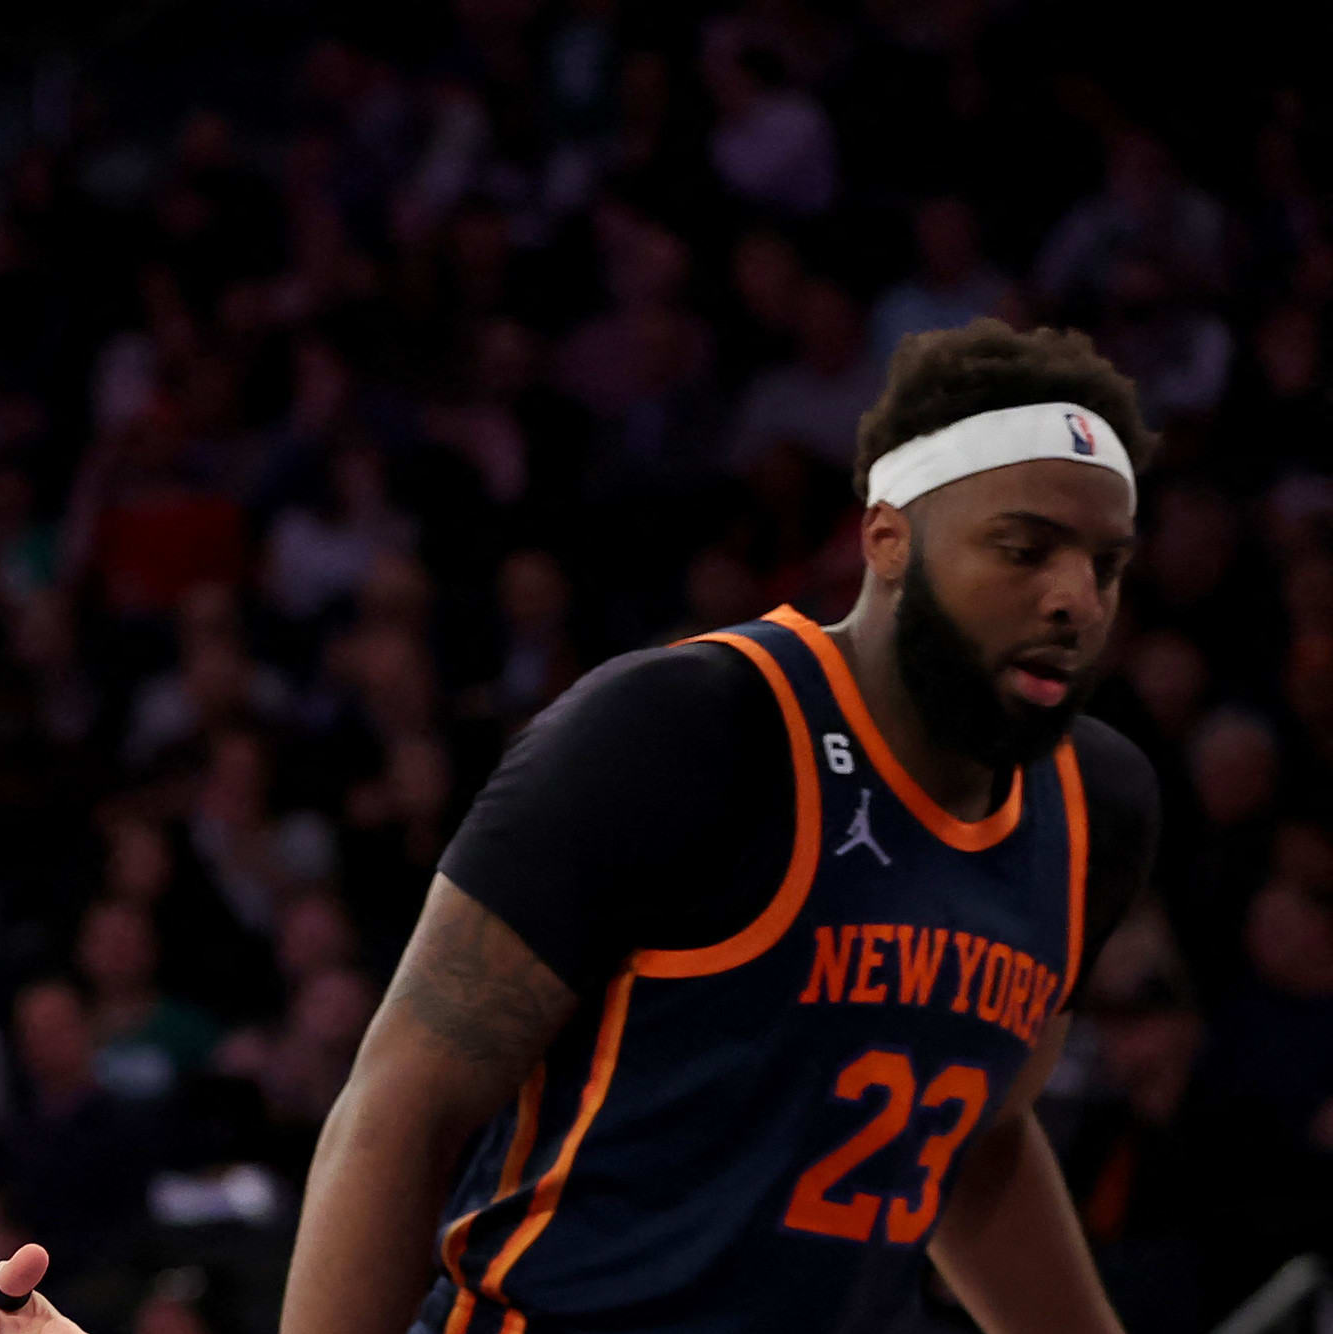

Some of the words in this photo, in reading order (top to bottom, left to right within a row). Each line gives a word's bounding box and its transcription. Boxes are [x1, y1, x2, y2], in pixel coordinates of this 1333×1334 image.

[822, 733, 854, 775] 6
[798, 924, 950, 1007] NEW
[950, 931, 1060, 1048] YORK
[783, 1049, 990, 1245] 23
